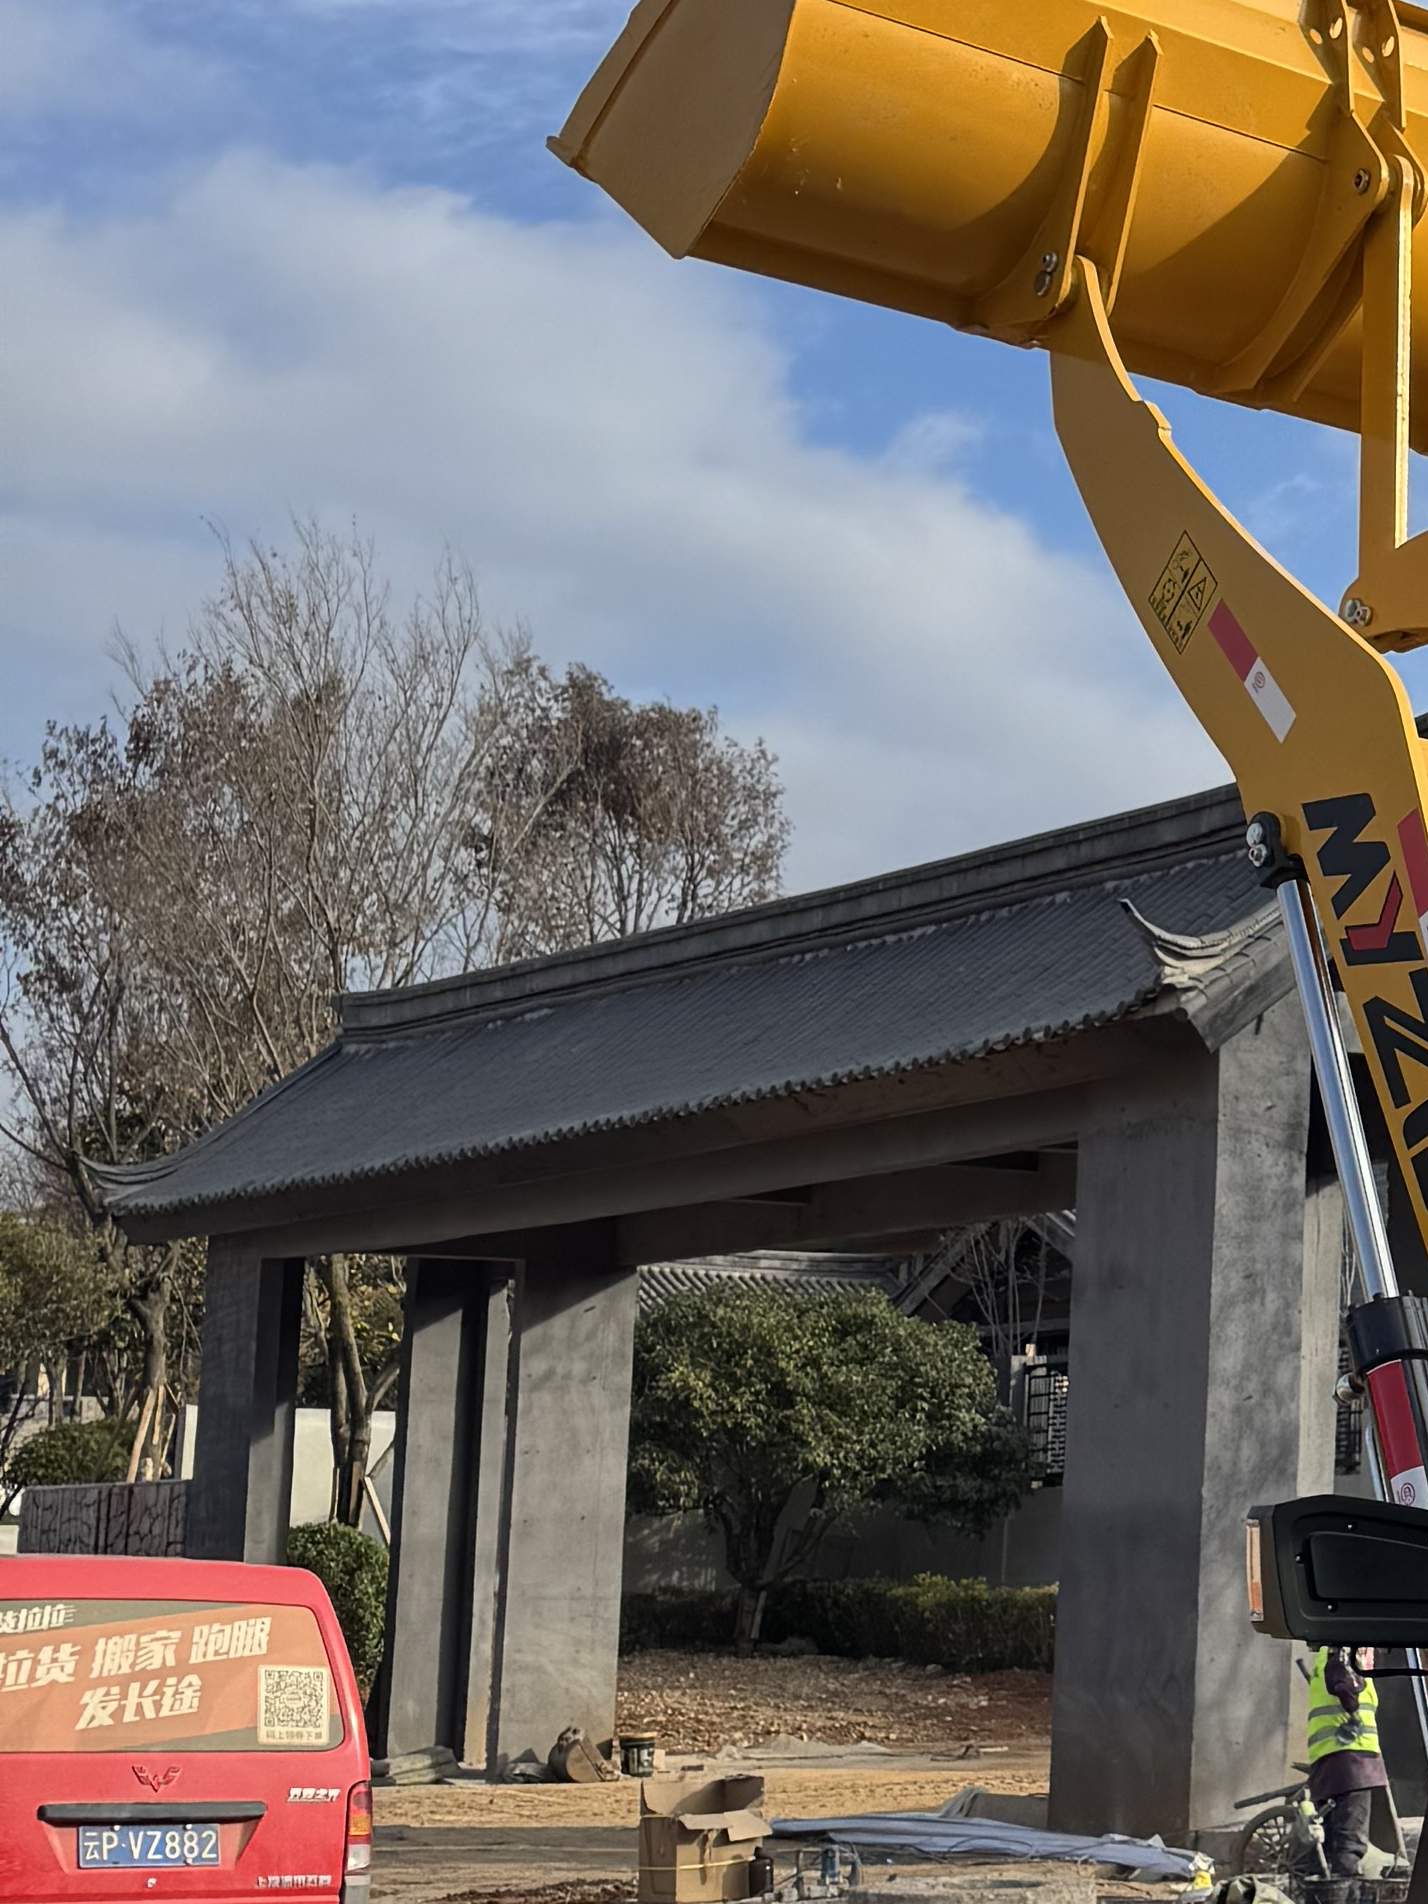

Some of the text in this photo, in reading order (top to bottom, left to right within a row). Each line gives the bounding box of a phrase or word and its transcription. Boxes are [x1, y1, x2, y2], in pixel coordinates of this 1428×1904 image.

[90, 1630, 182, 1678] 搬家
[189, 1617, 272, 1664] 跑腿
[75, 1674, 202, 1730] 发长途
